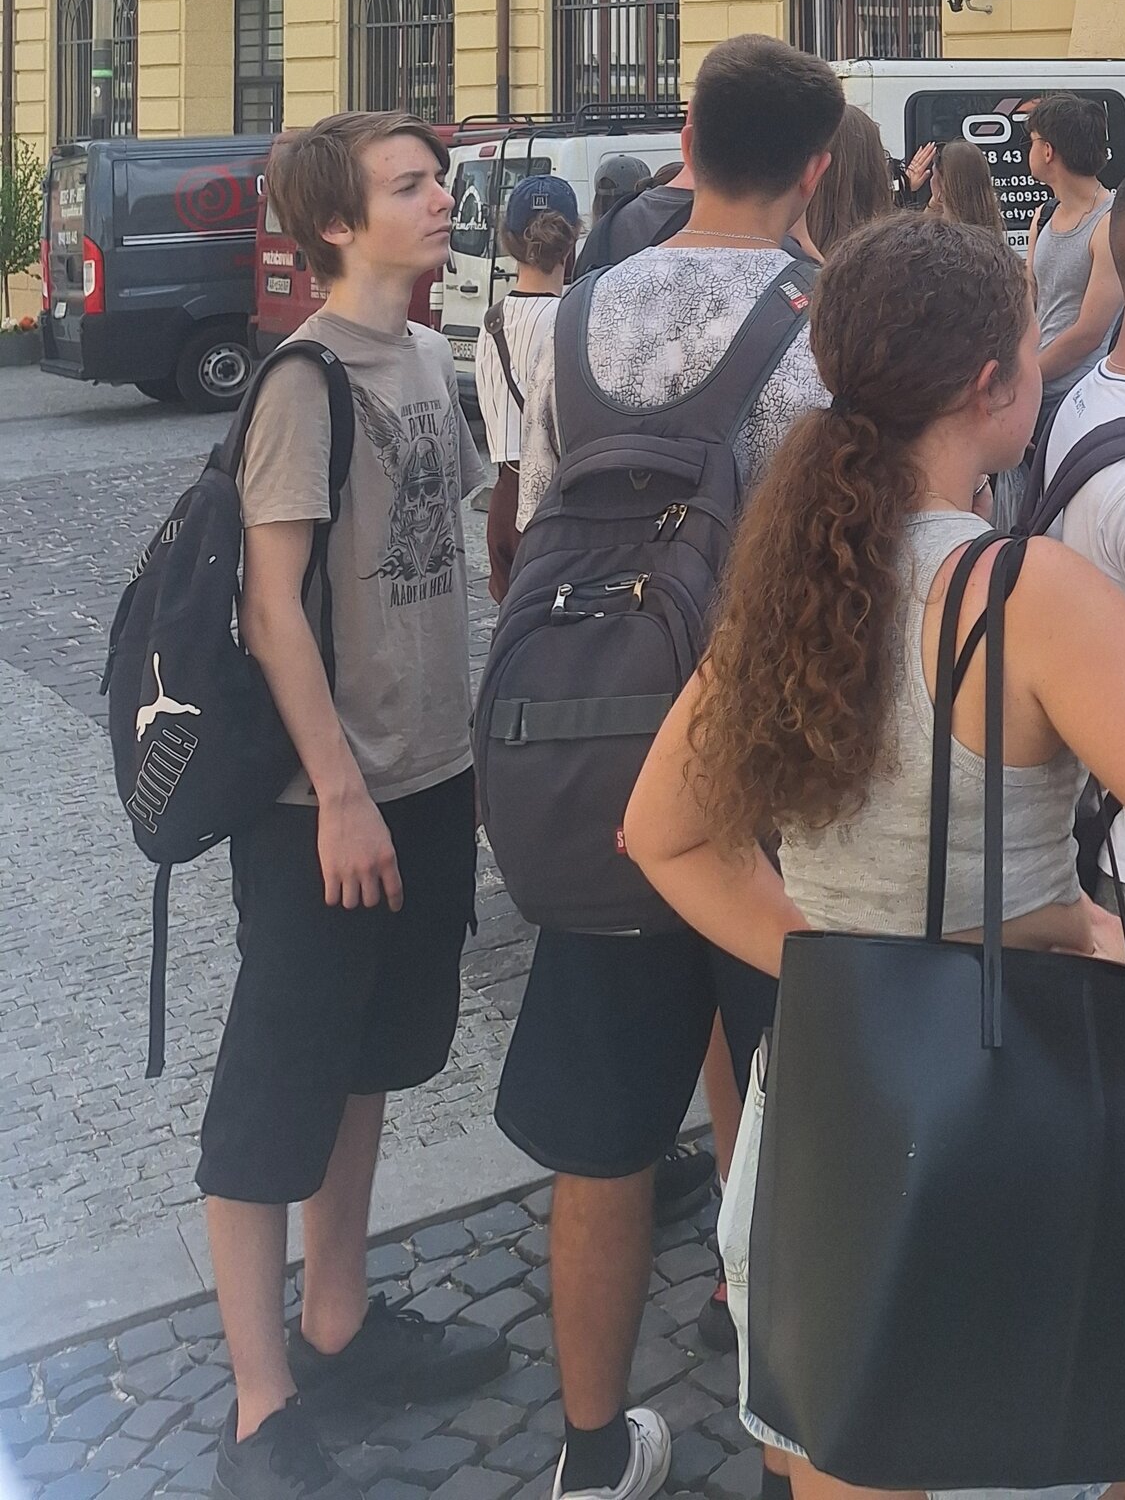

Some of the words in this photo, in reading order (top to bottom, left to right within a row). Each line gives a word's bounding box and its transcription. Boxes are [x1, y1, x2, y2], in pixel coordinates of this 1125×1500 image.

[1002, 150, 1023, 163] 43
[408, 412, 438, 442] DEVIL
[390, 582, 418, 607] MADE
[419, 582, 427, 601] IN
[429, 568, 453, 599] HELL
[125, 723, 199, 835] PUMA
